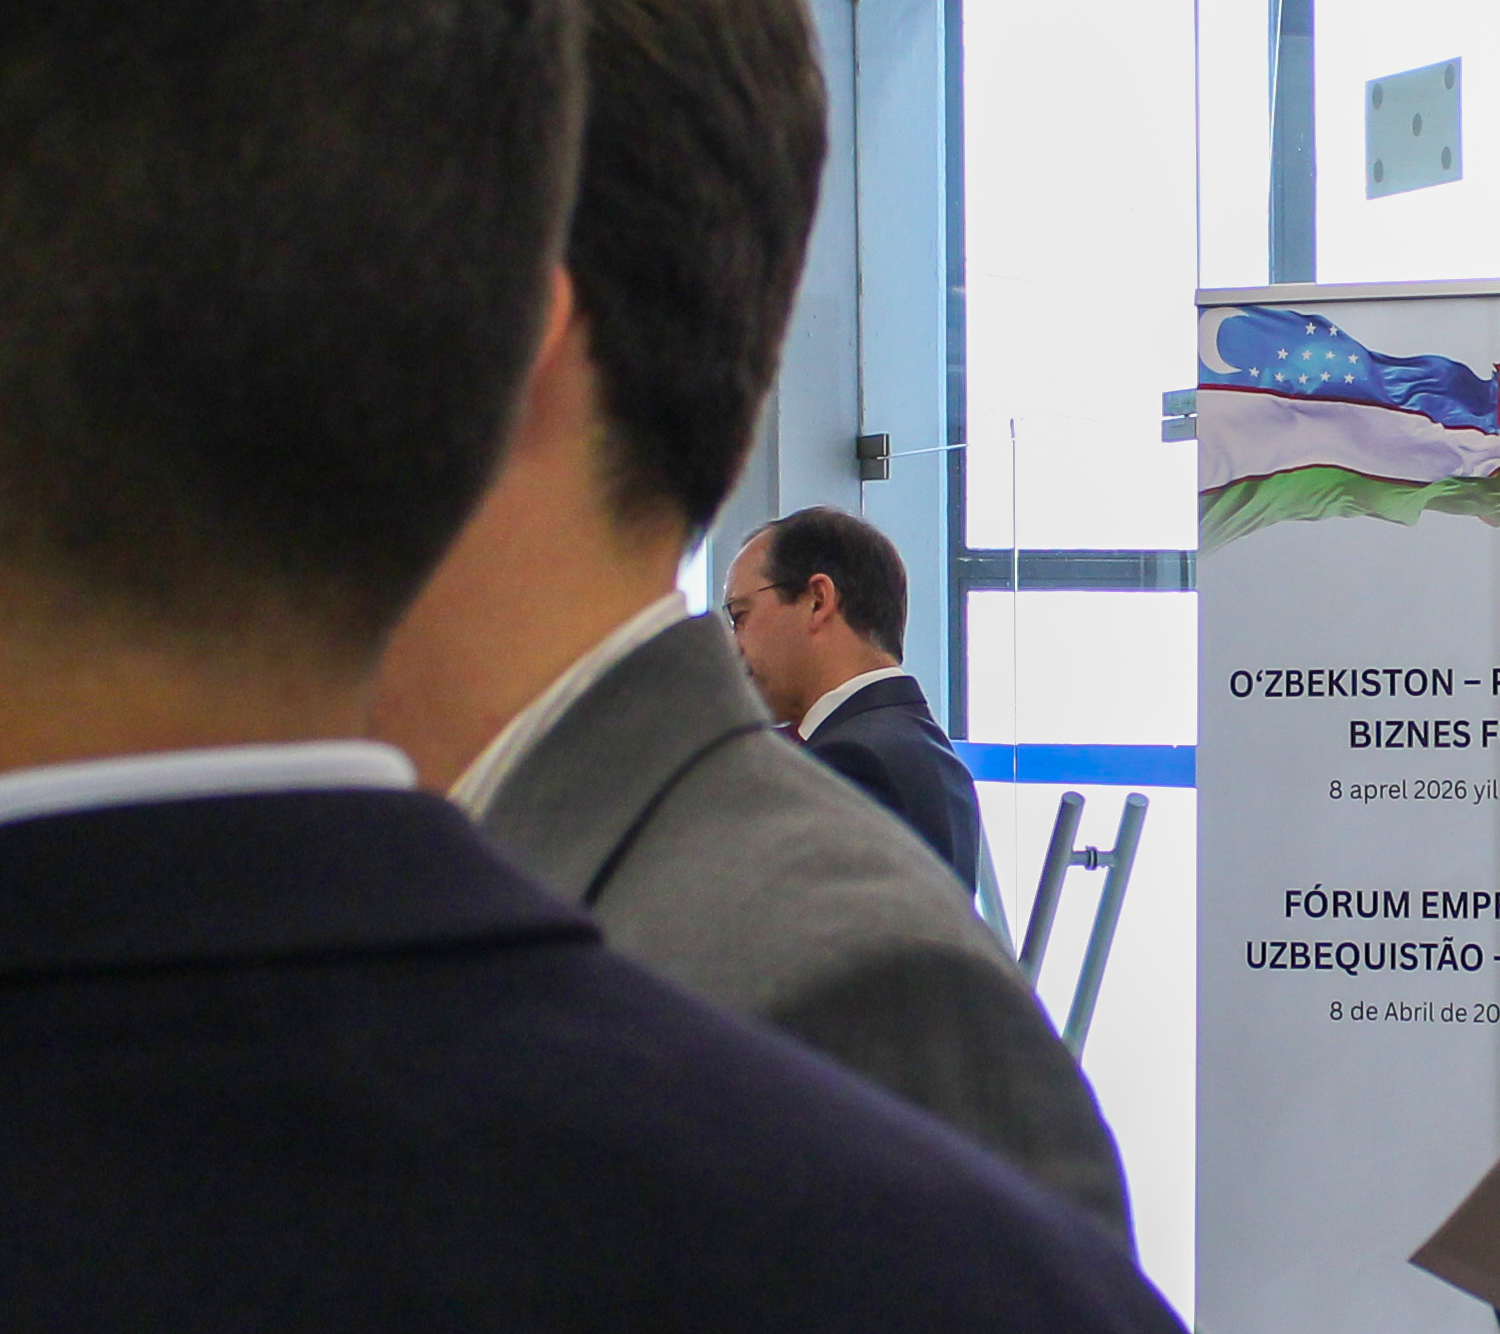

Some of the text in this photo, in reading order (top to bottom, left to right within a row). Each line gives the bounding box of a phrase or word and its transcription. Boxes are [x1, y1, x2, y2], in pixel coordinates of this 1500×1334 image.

[1349, 719, 1472, 750] BIZNES
[1329, 779, 1343, 801] 8
[1349, 778, 1408, 805] aprel
[1413, 779, 1468, 801] 2026
[1472, 778, 1499, 806] yil
[1285, 883, 1411, 920] FÓRUM
[1246, 935, 1484, 977] UZBEQUISTÃO
[1329, 1000, 1344, 1022] 8
[1350, 1000, 1379, 1022] de
[1383, 1000, 1435, 1023] Abril
[1440, 1002, 1468, 1023] de
